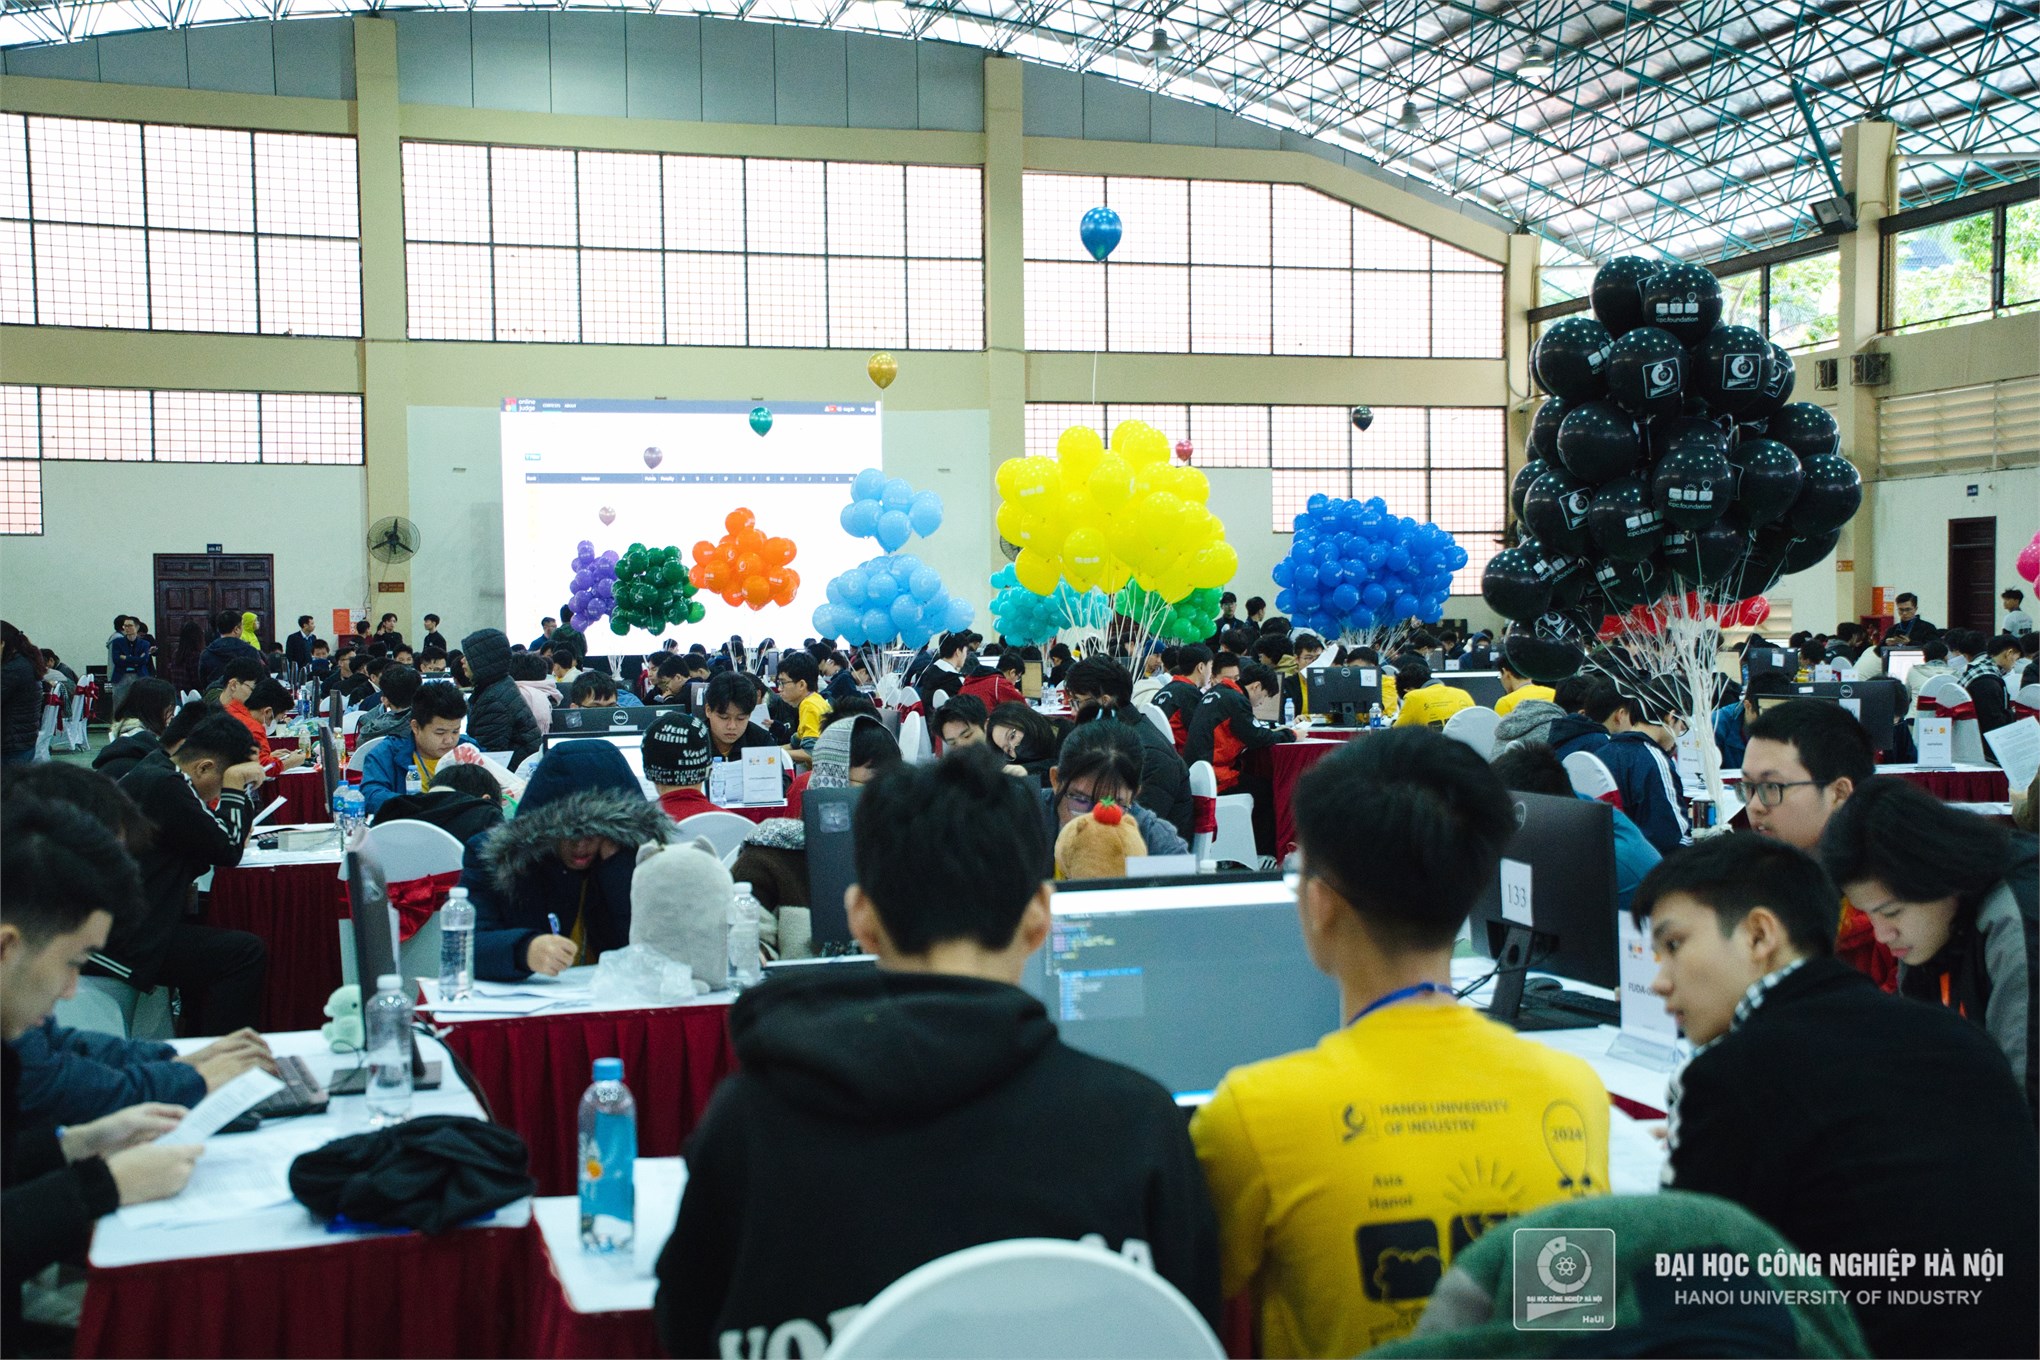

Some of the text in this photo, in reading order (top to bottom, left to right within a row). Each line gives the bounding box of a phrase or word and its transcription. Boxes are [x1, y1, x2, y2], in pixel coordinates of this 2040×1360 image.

[1507, 884, 1527, 908] 133
[1380, 1100, 1509, 1116] HANOI UNIVERSITY
[1384, 1118, 1477, 1136] OF INDUSTRY
[1372, 1174, 1404, 1187] Asia
[1368, 1193, 1413, 1210] Hanoi
